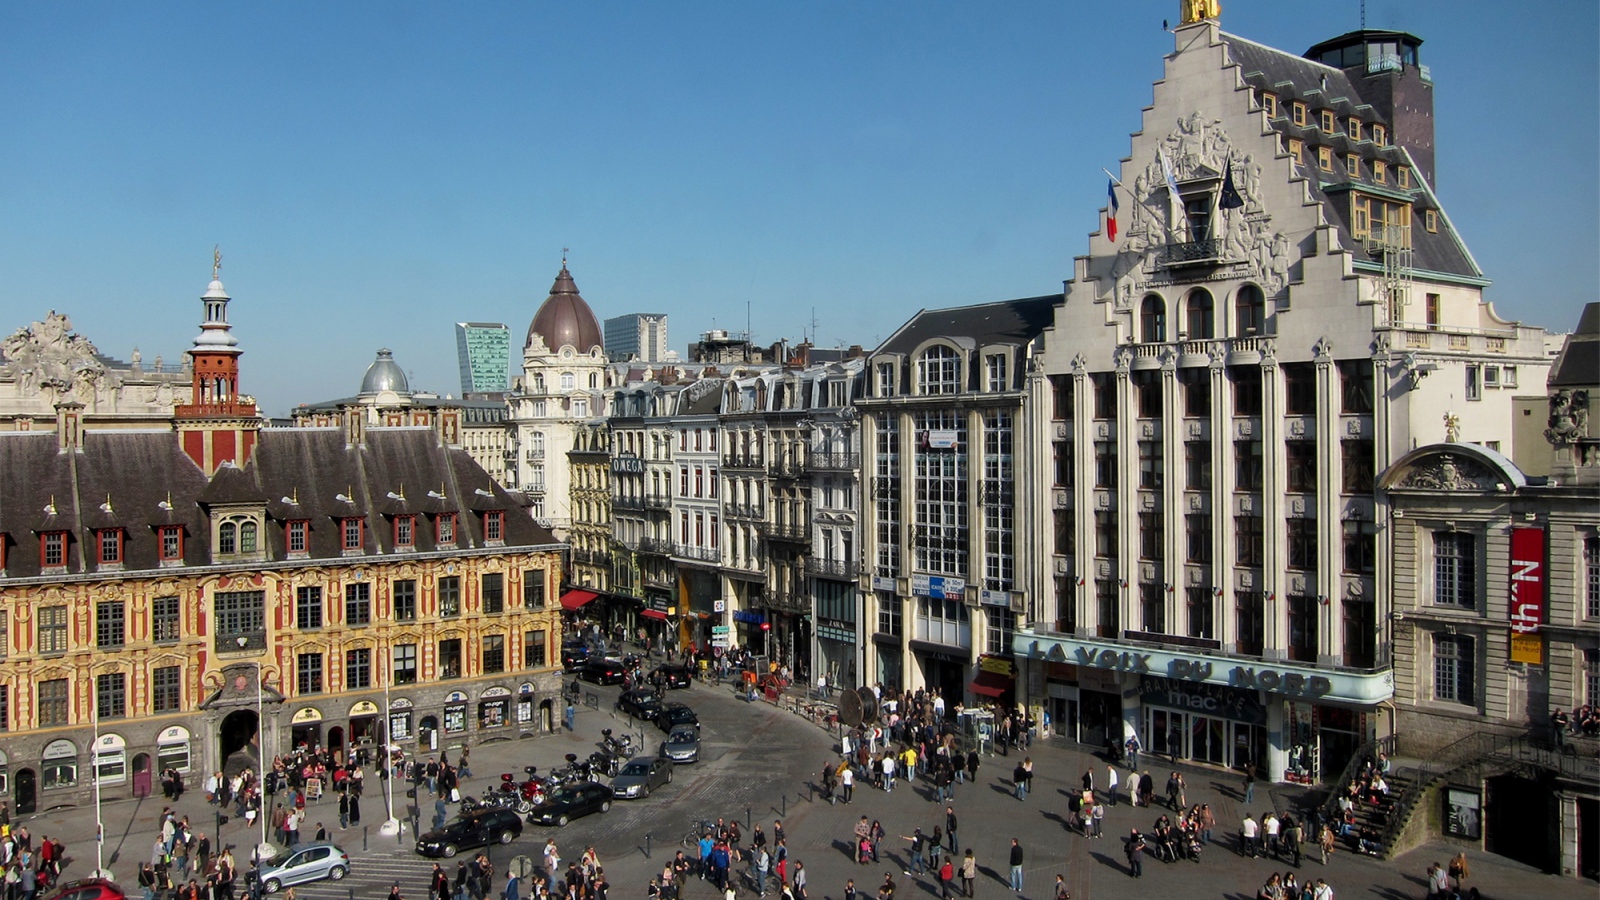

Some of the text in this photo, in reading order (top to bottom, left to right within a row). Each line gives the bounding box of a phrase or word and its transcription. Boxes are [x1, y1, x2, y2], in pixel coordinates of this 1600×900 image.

[613, 459, 643, 472] OMEGA
[829, 620, 845, 629] ZARA
[1030, 640, 1331, 698] LA VOIX DU NORD
[1197, 682, 1246, 711] PLACE
